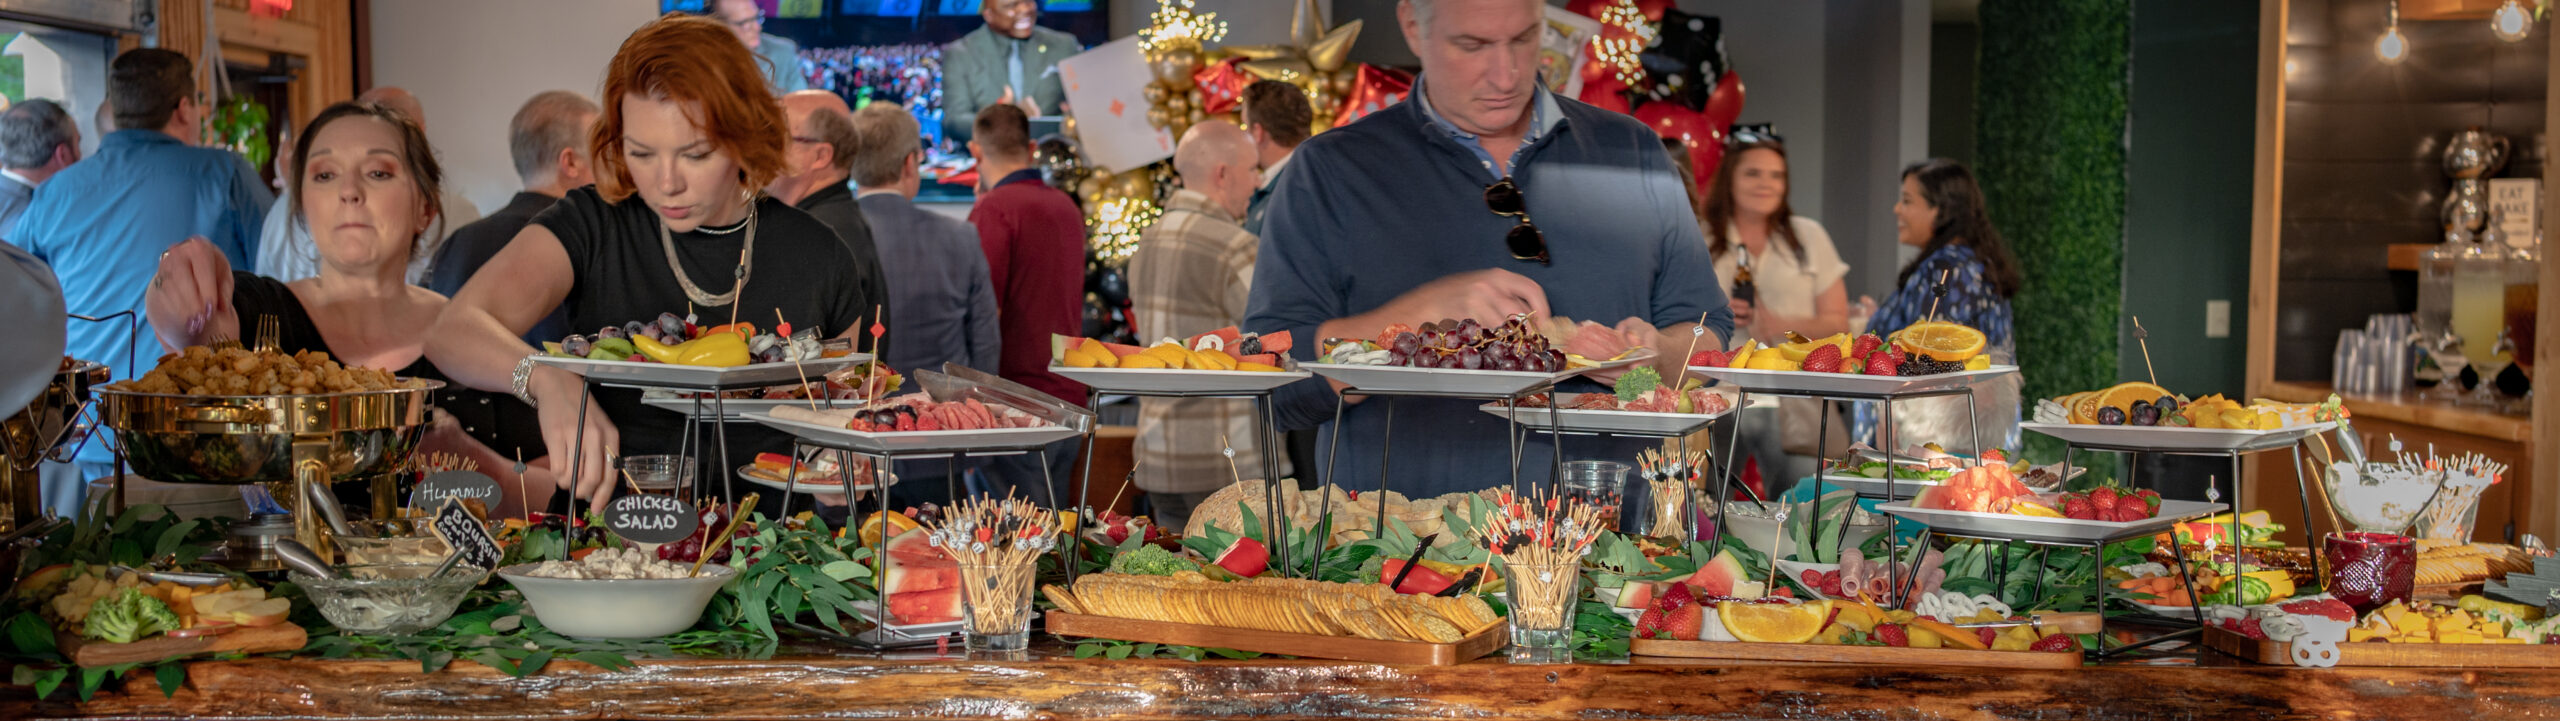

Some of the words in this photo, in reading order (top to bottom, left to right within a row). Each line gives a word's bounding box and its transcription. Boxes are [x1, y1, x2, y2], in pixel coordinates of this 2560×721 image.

[2498, 186, 2525, 199] EAT
[614, 513, 678, 531] SALAD
[452, 508, 502, 564] BOURSIN
